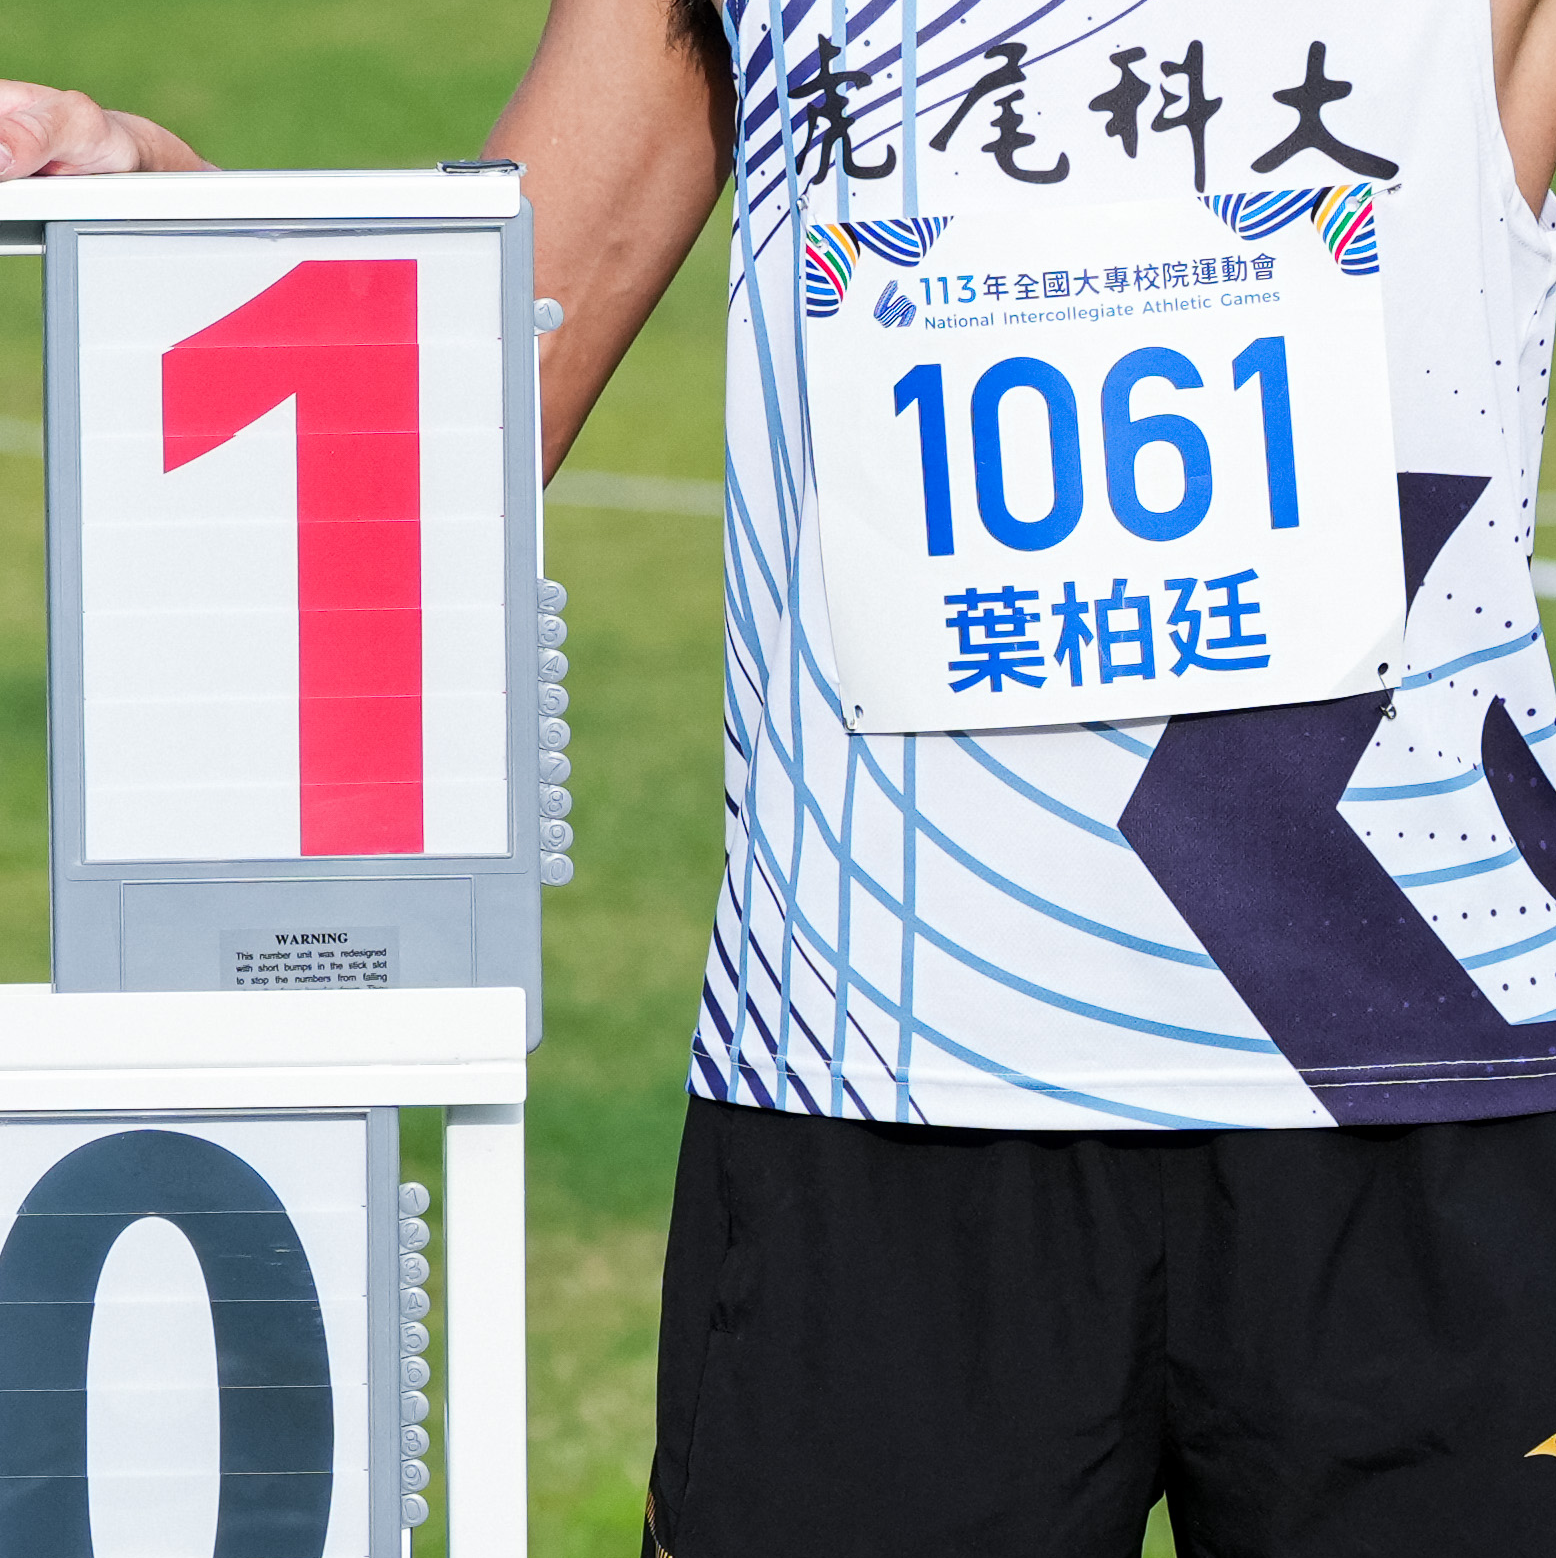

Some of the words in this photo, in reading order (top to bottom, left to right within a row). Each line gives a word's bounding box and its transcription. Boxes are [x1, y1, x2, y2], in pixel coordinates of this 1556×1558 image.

[787, 33, 1400, 193] 虎尾科大
[924, 311, 994, 330] National
[1003, 302, 1135, 325] Intercollegiate
[1142, 294, 1213, 315] Athletic
[1220, 288, 1282, 307] Games
[893, 336, 1300, 558] 1061
[944, 567, 1272, 694] 葉柏廷
[275, 932, 348, 945] WARNING
[236, 952, 254, 961] This
[259, 951, 291, 959] number
[297, 950, 312, 958] unit
[341, 948, 387, 959] redesigned
[236, 964, 253, 973] with
[258, 963, 279, 973] short
[284, 962, 312, 974] bumps
[317, 962, 325, 970] in
[330, 961, 343, 970] the
[348, 960, 367, 970] stick
[372, 960, 387, 969] slot
[236, 977, 245, 985] to
[251, 976, 269, 986] stop
[275, 976, 288, 984] the
[295, 974, 331, 983] numbers
[338, 973, 356, 982] from
[363, 972, 387, 984] falling
